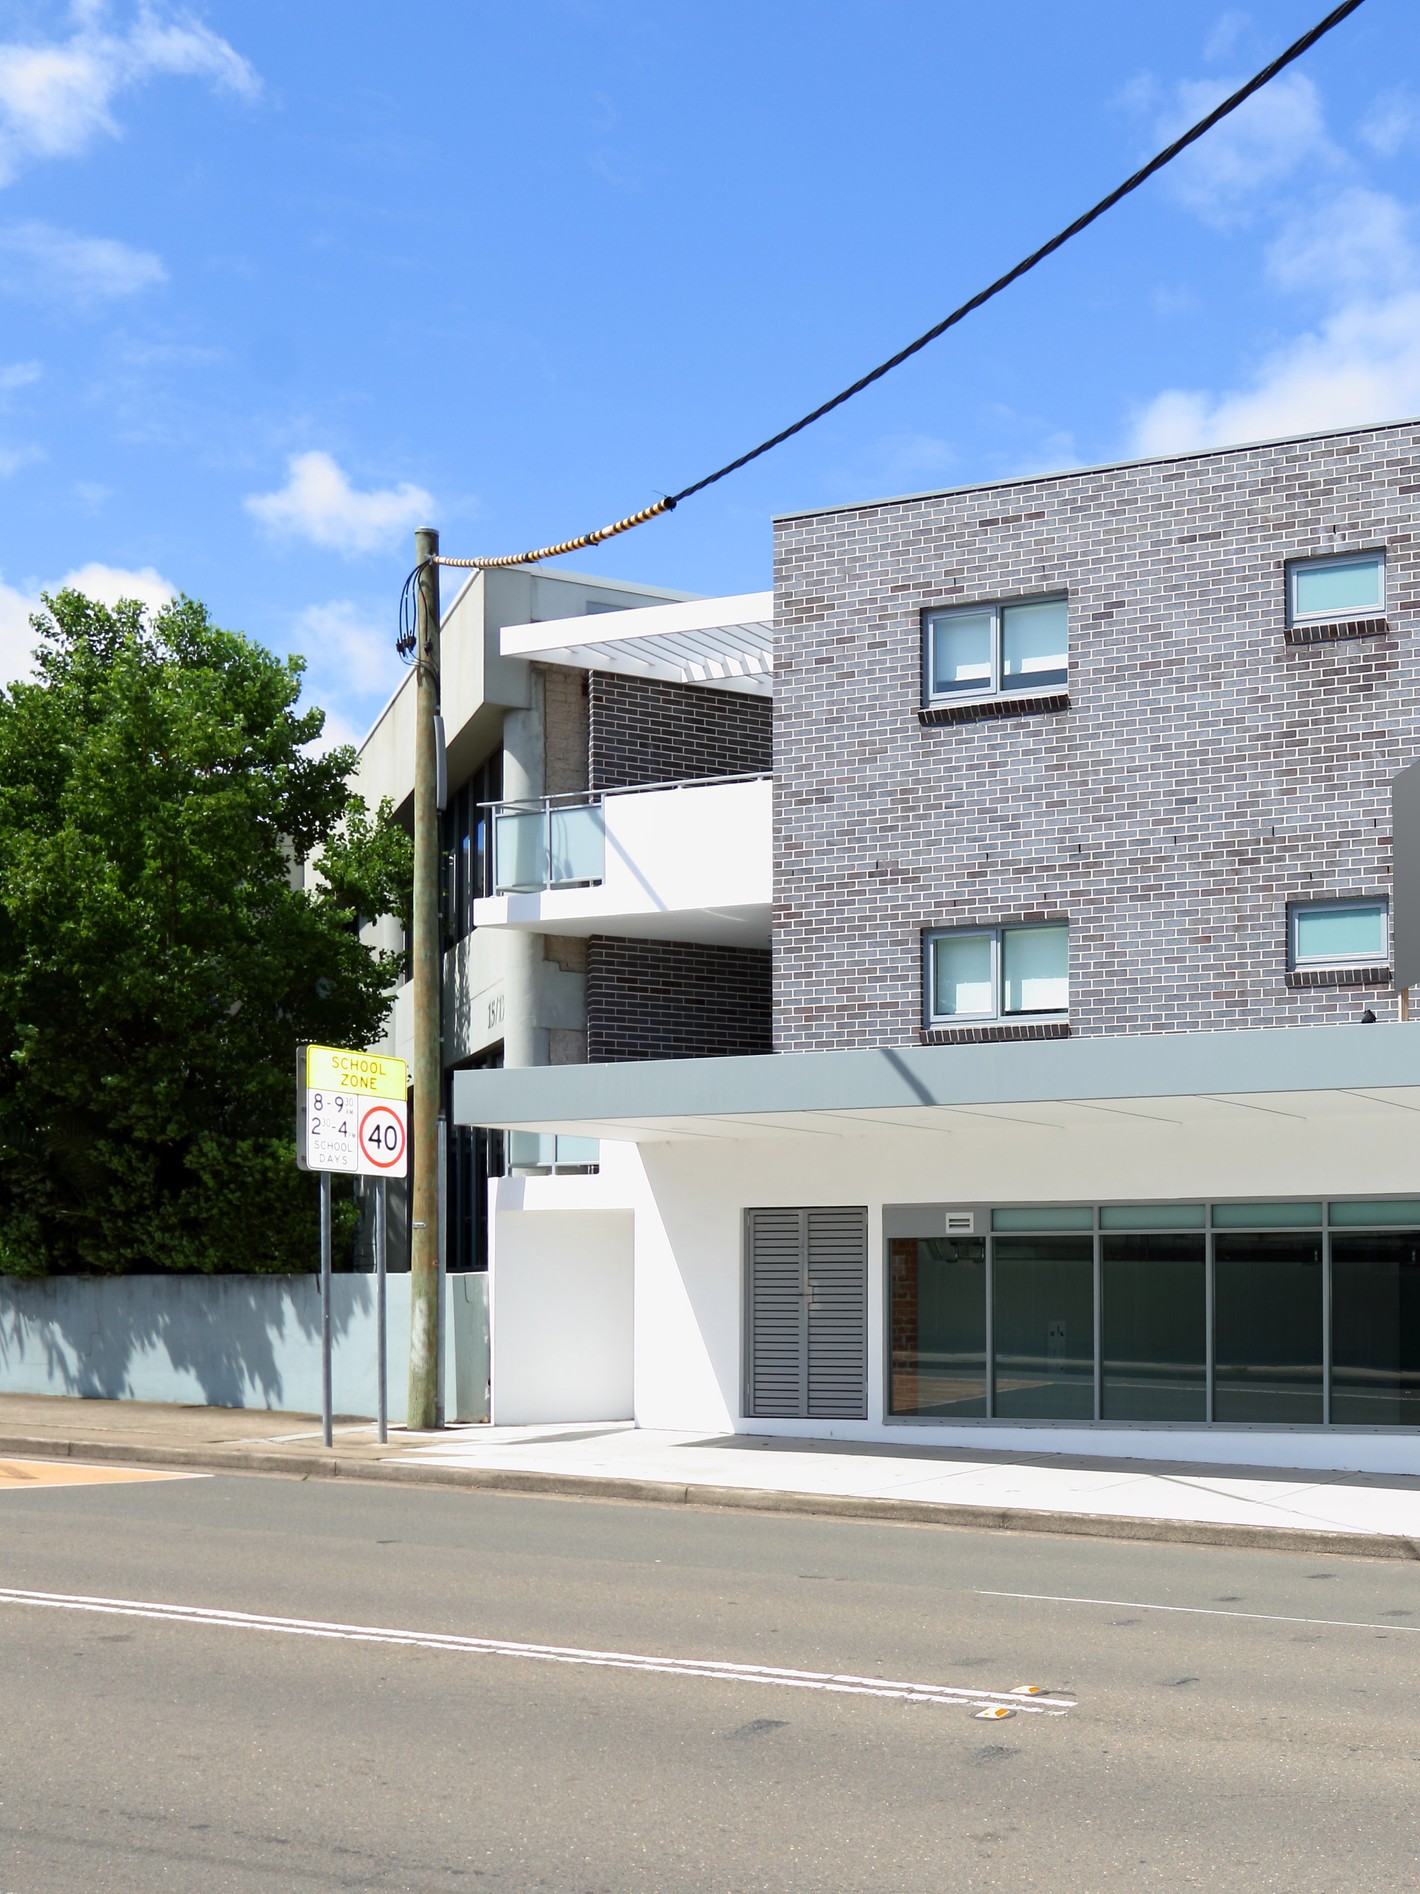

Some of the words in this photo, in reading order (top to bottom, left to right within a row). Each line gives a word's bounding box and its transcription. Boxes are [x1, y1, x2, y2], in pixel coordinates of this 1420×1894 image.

[331, 1056, 387, 1076] SCHOOL
[341, 1074, 377, 1090] ZONE
[368, 1124, 398, 1151] 40
[314, 1140, 353, 1153] SCHOOL
[319, 1153, 348, 1165] DAYS
